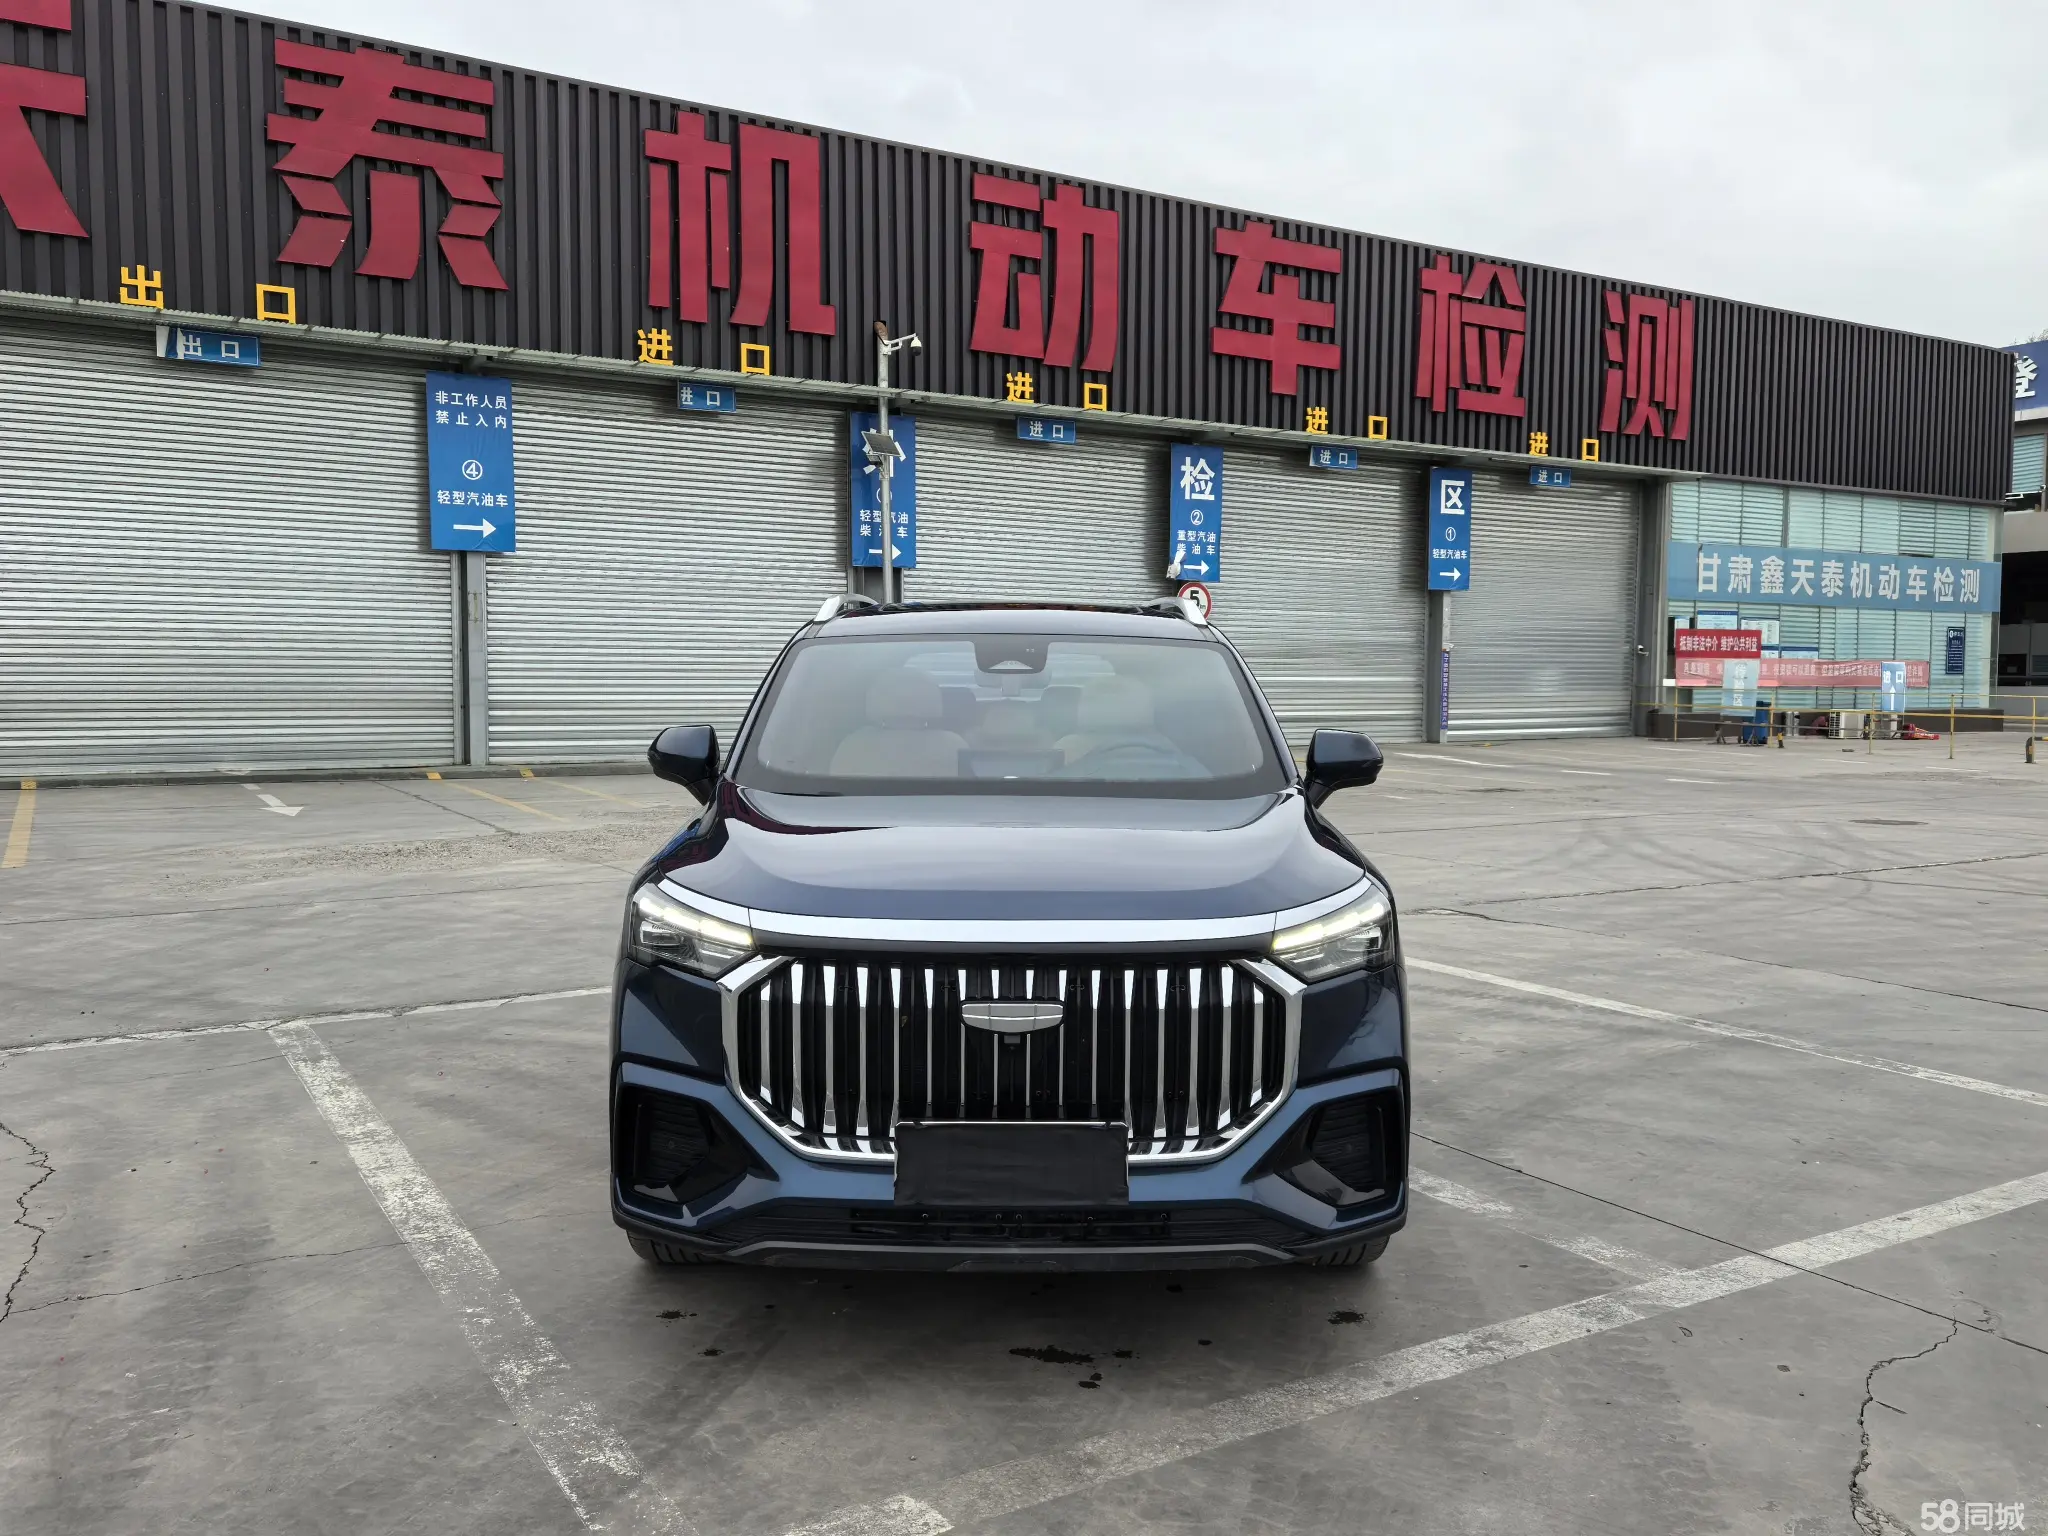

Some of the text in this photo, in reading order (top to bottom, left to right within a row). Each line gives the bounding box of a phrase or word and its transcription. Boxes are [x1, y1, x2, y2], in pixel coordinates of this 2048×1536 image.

[120, 265, 296, 324] 出口
[182, 334, 240, 358] 出口
[638, 328, 770, 375] 进口
[435, 391, 508, 410] 非工作人员
[1006, 371, 1108, 412] 进口
[435, 410, 507, 429] 禁止入内
[1029, 421, 1064, 438] 进口
[1305, 406, 1388, 440] 进口
[1320, 449, 1348, 465] 进口
[1528, 432, 1599, 462] 进口
[1180, 456, 1216, 500] 检
[1538, 470, 1562, 483] 进口
[437, 490, 509, 507] 轻型汽油车
[1440, 480, 1465, 515] 区
[1176, 529, 1217, 543] 重型汽油
[1432, 548, 1468, 560] 轻型汽油车
[1697, 552, 1981, 603] 甘肃鑫天泰机动车检测
